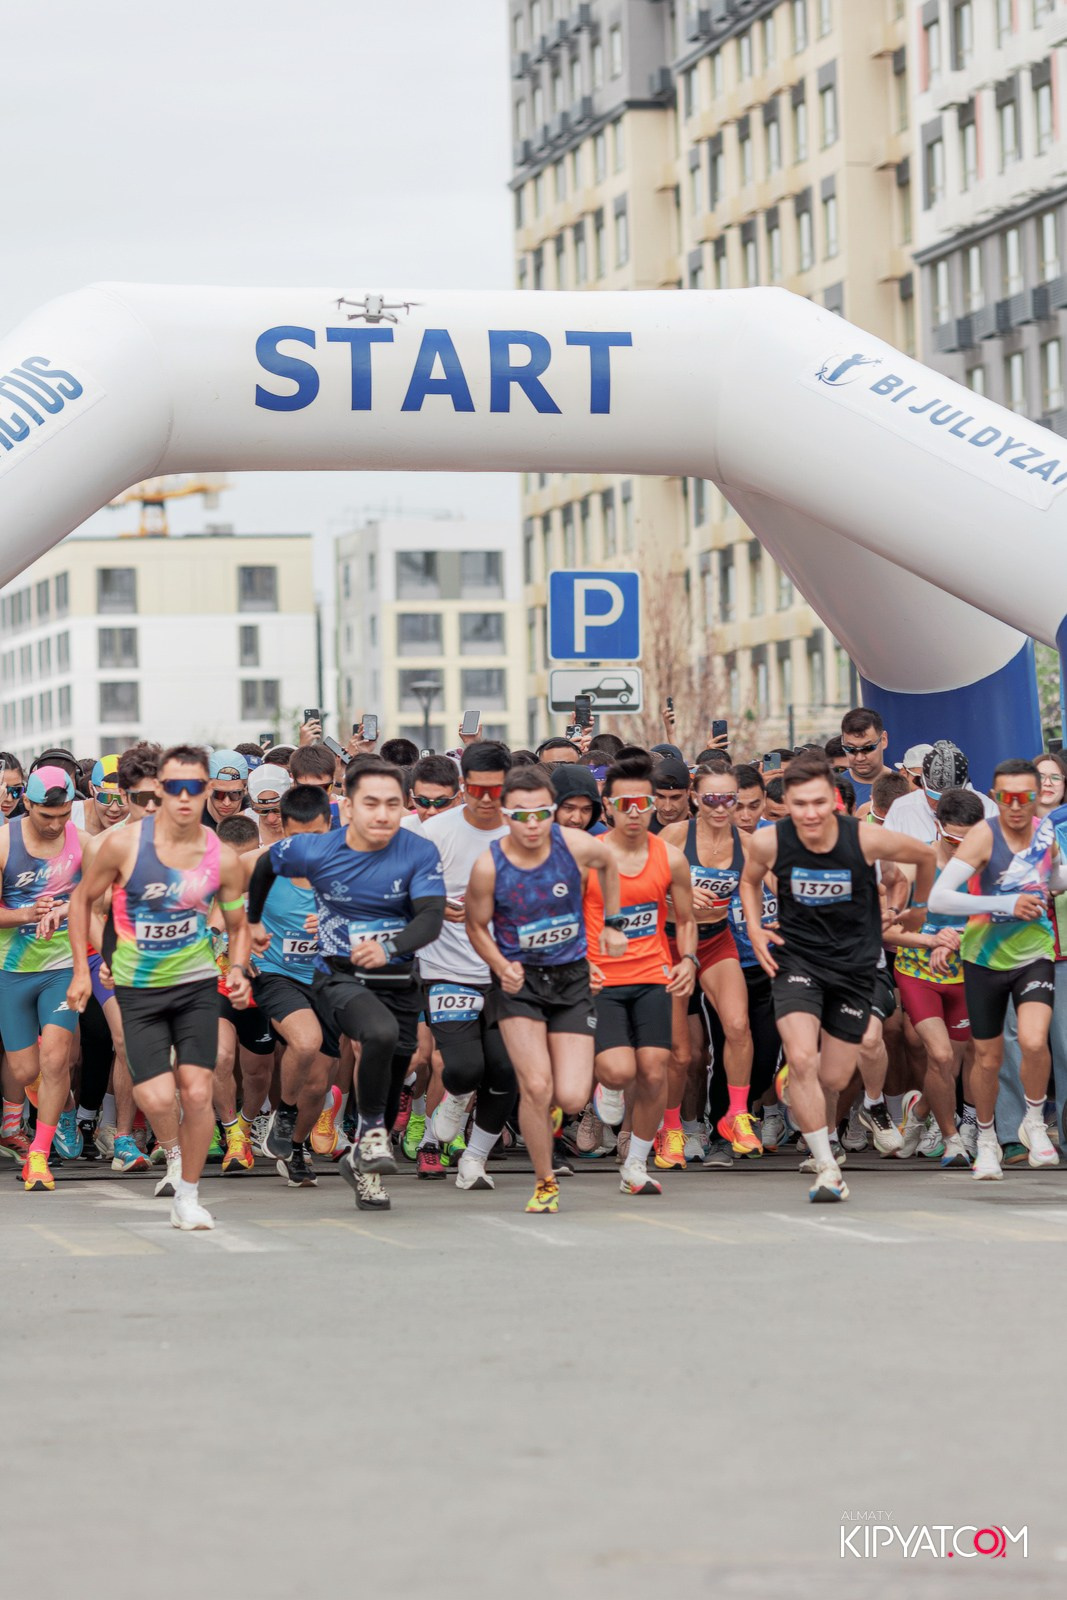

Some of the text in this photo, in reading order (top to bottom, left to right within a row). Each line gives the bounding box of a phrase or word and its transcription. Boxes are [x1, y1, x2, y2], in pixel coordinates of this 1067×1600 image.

[255, 325, 633, 415] START
[869, 374, 917, 403] BI
[574, 578, 625, 653] P
[694, 879, 732, 892] 1666
[800, 882, 843, 895] 1370
[144, 921, 190, 938] 1384
[528, 927, 572, 947] 1459
[437, 996, 476, 1010] 1031
